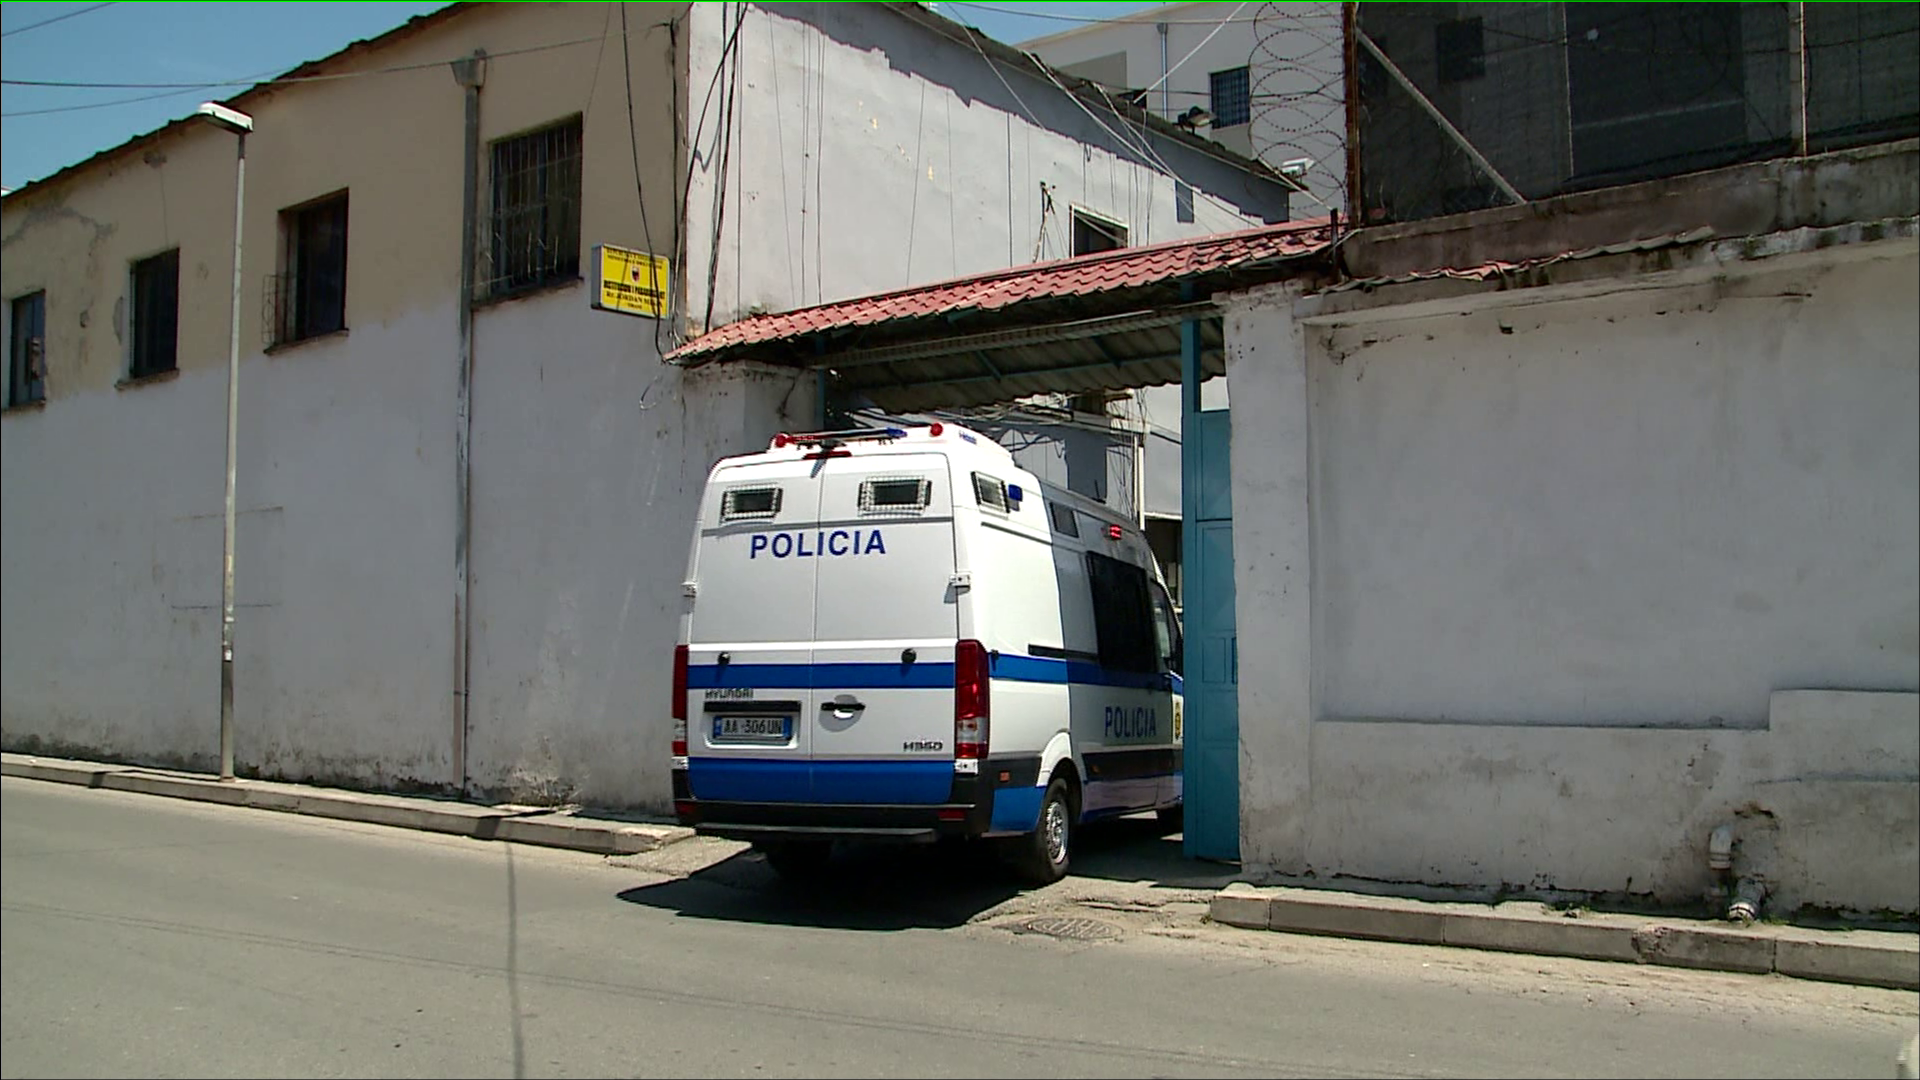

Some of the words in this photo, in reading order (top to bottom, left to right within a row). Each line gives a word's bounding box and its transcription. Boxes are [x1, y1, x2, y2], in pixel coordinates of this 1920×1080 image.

[750, 529, 886, 559] POLICIA
[705, 687, 754, 699] HYUNDAI
[724, 719, 738, 733] AA
[1105, 706, 1156, 738] POLICIA
